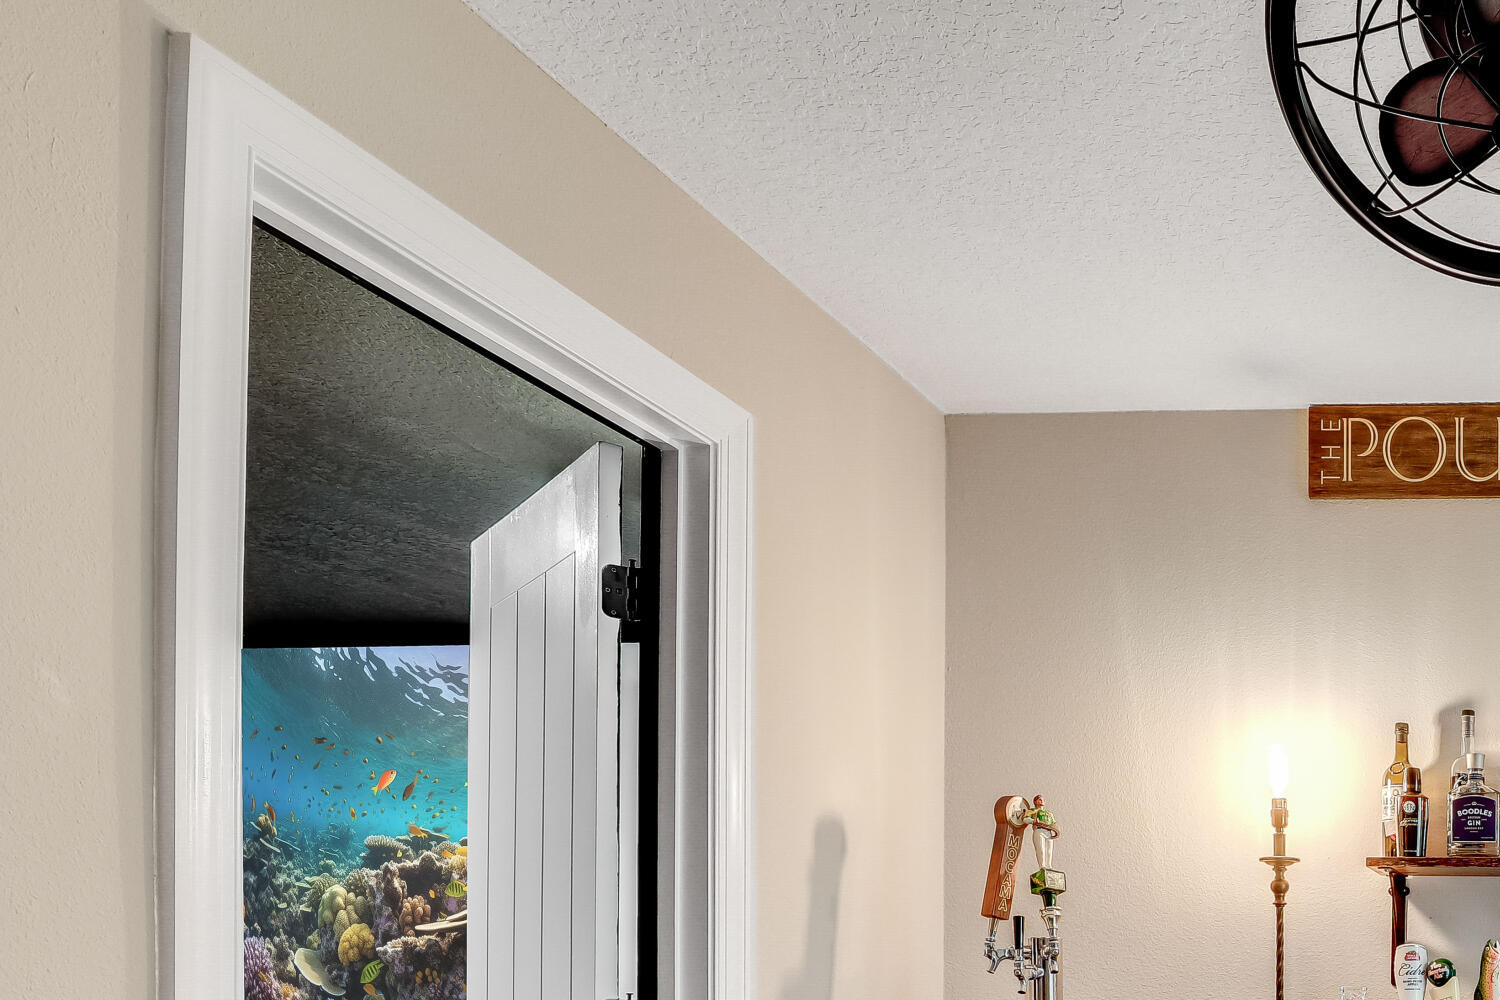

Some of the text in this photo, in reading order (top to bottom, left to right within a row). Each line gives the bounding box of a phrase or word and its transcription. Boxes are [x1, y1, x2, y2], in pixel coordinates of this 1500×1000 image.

[1320, 417, 1341, 484] THE
[1457, 808, 1493, 818] BOODLES
[998, 834, 1020, 912] MOCAMA
[1399, 962, 1426, 977] Cidre
